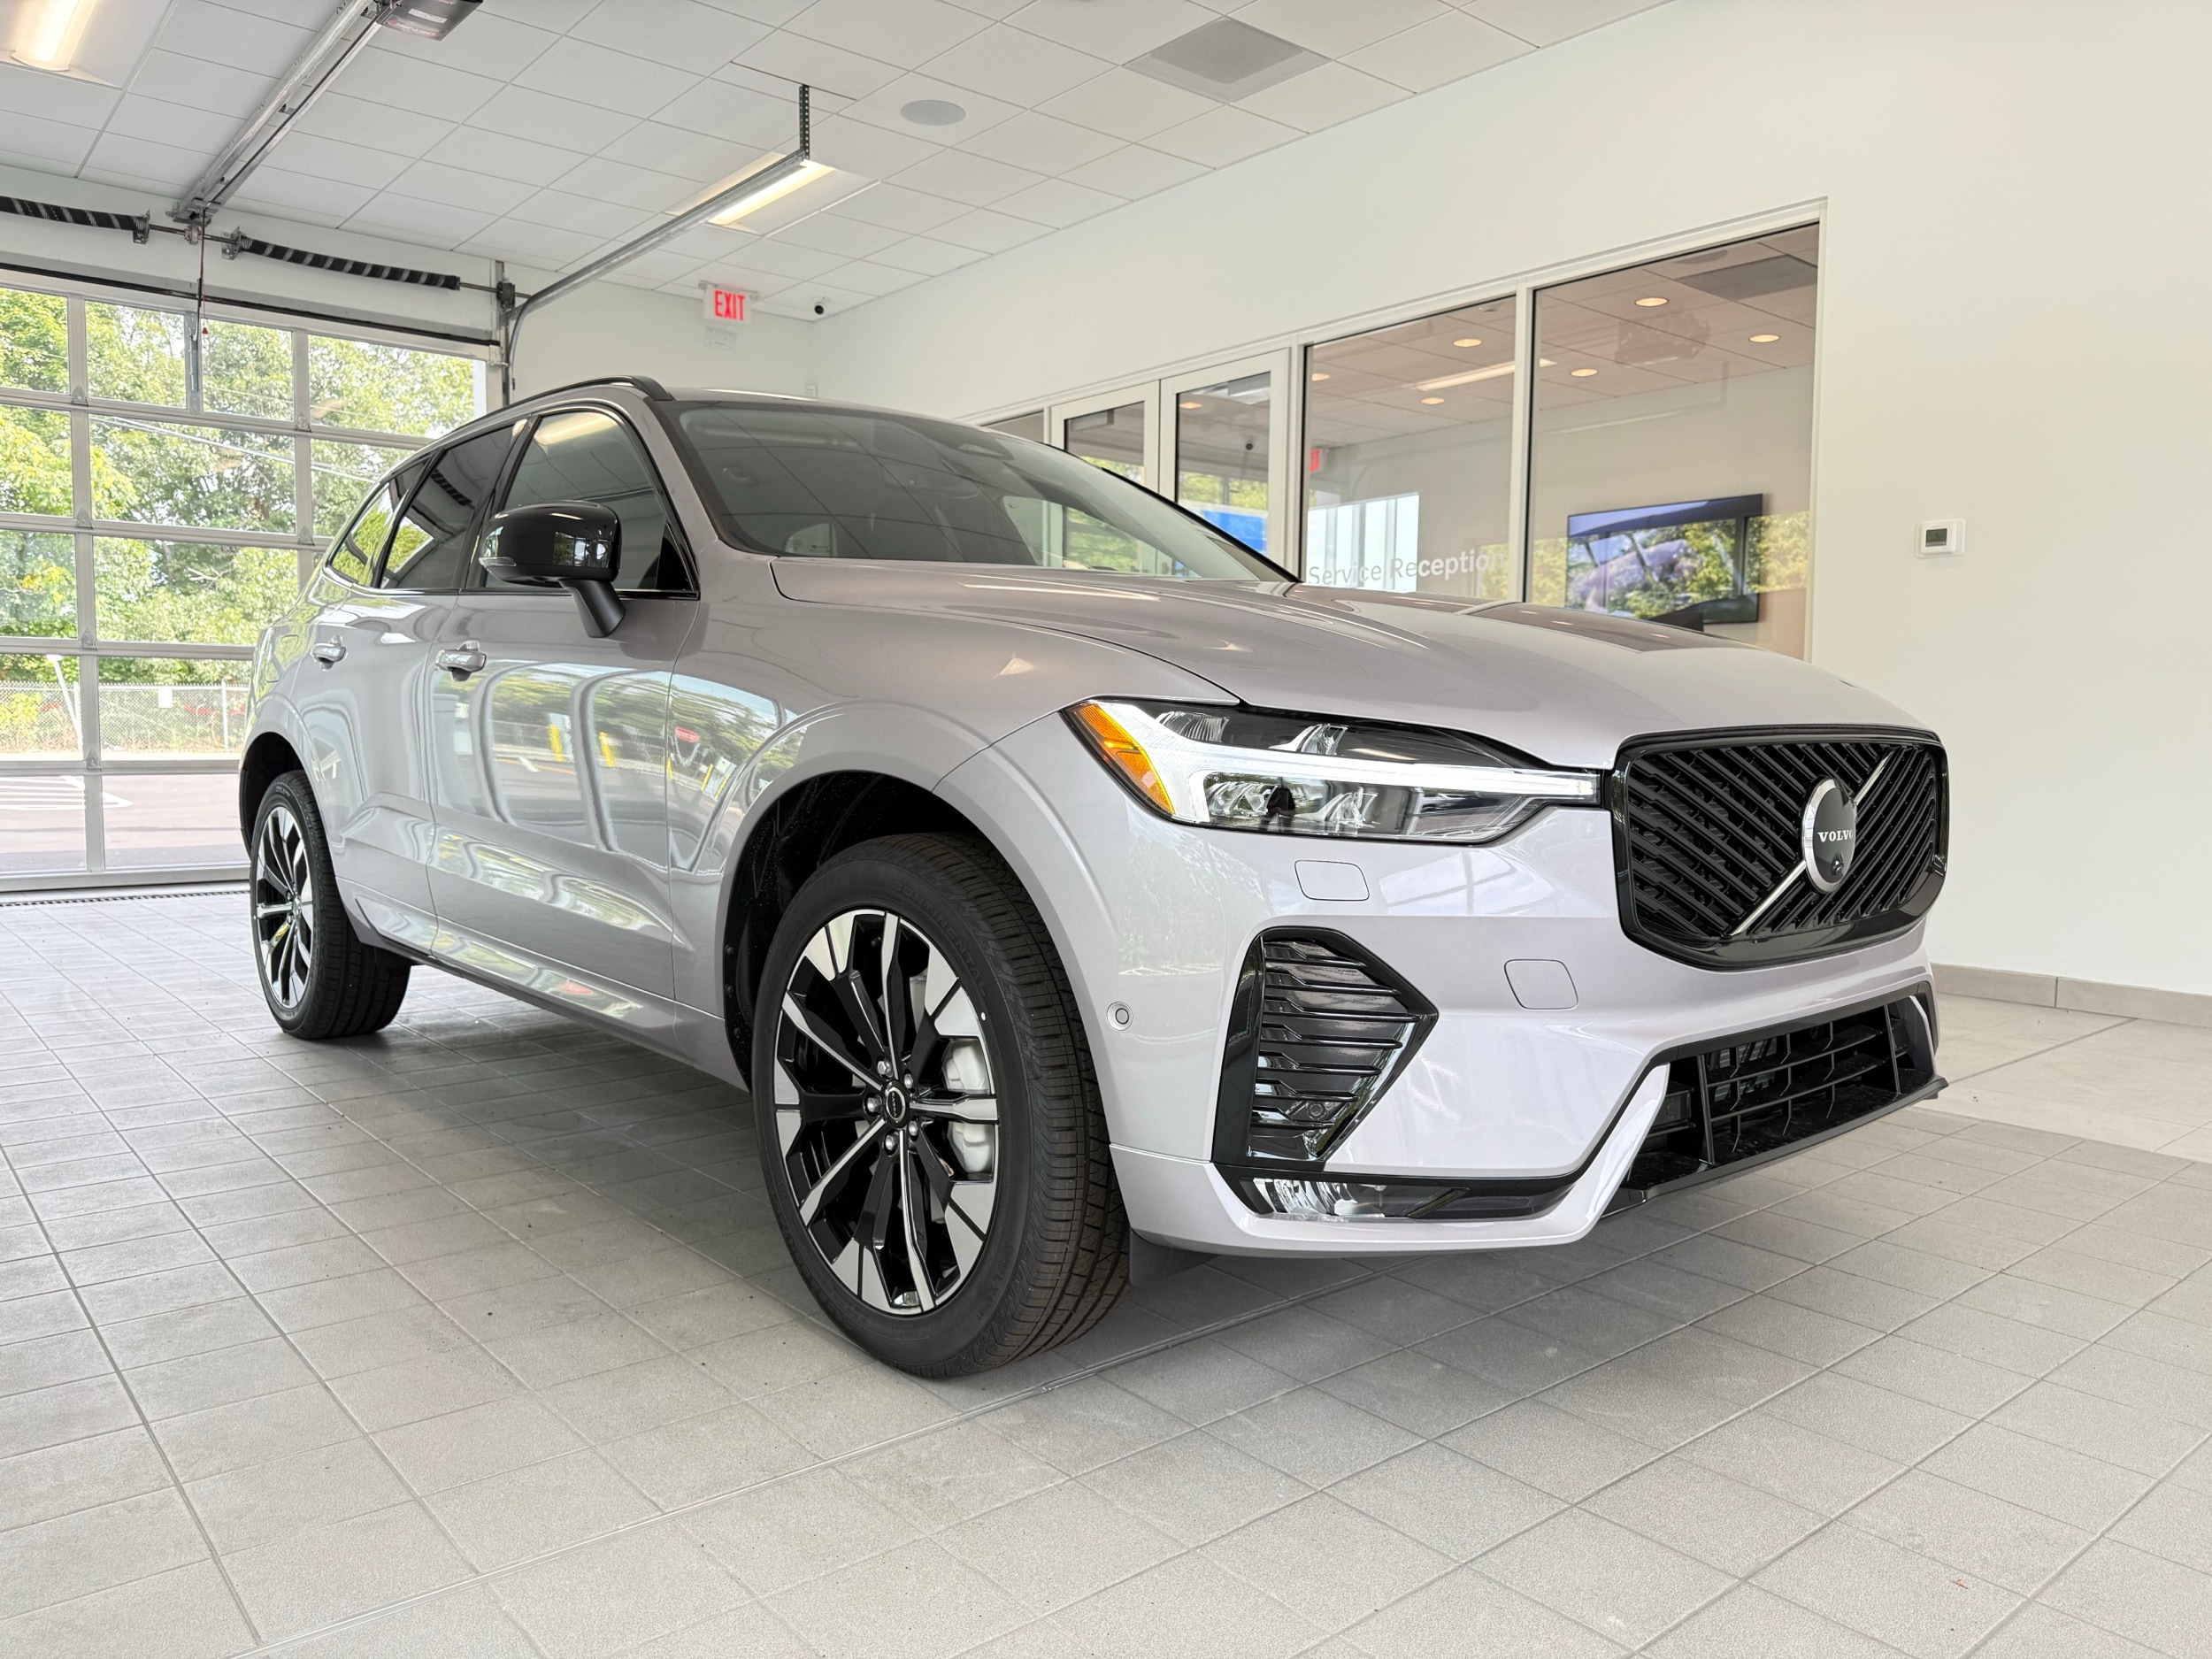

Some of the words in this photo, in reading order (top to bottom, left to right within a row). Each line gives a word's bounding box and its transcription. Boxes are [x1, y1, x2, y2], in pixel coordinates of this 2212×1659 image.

[714, 289, 745, 321] EXIT
[1309, 562, 1381, 585] Service
[1390, 547, 1506, 580] Reception
[1817, 829, 1854, 843] VOLVO
